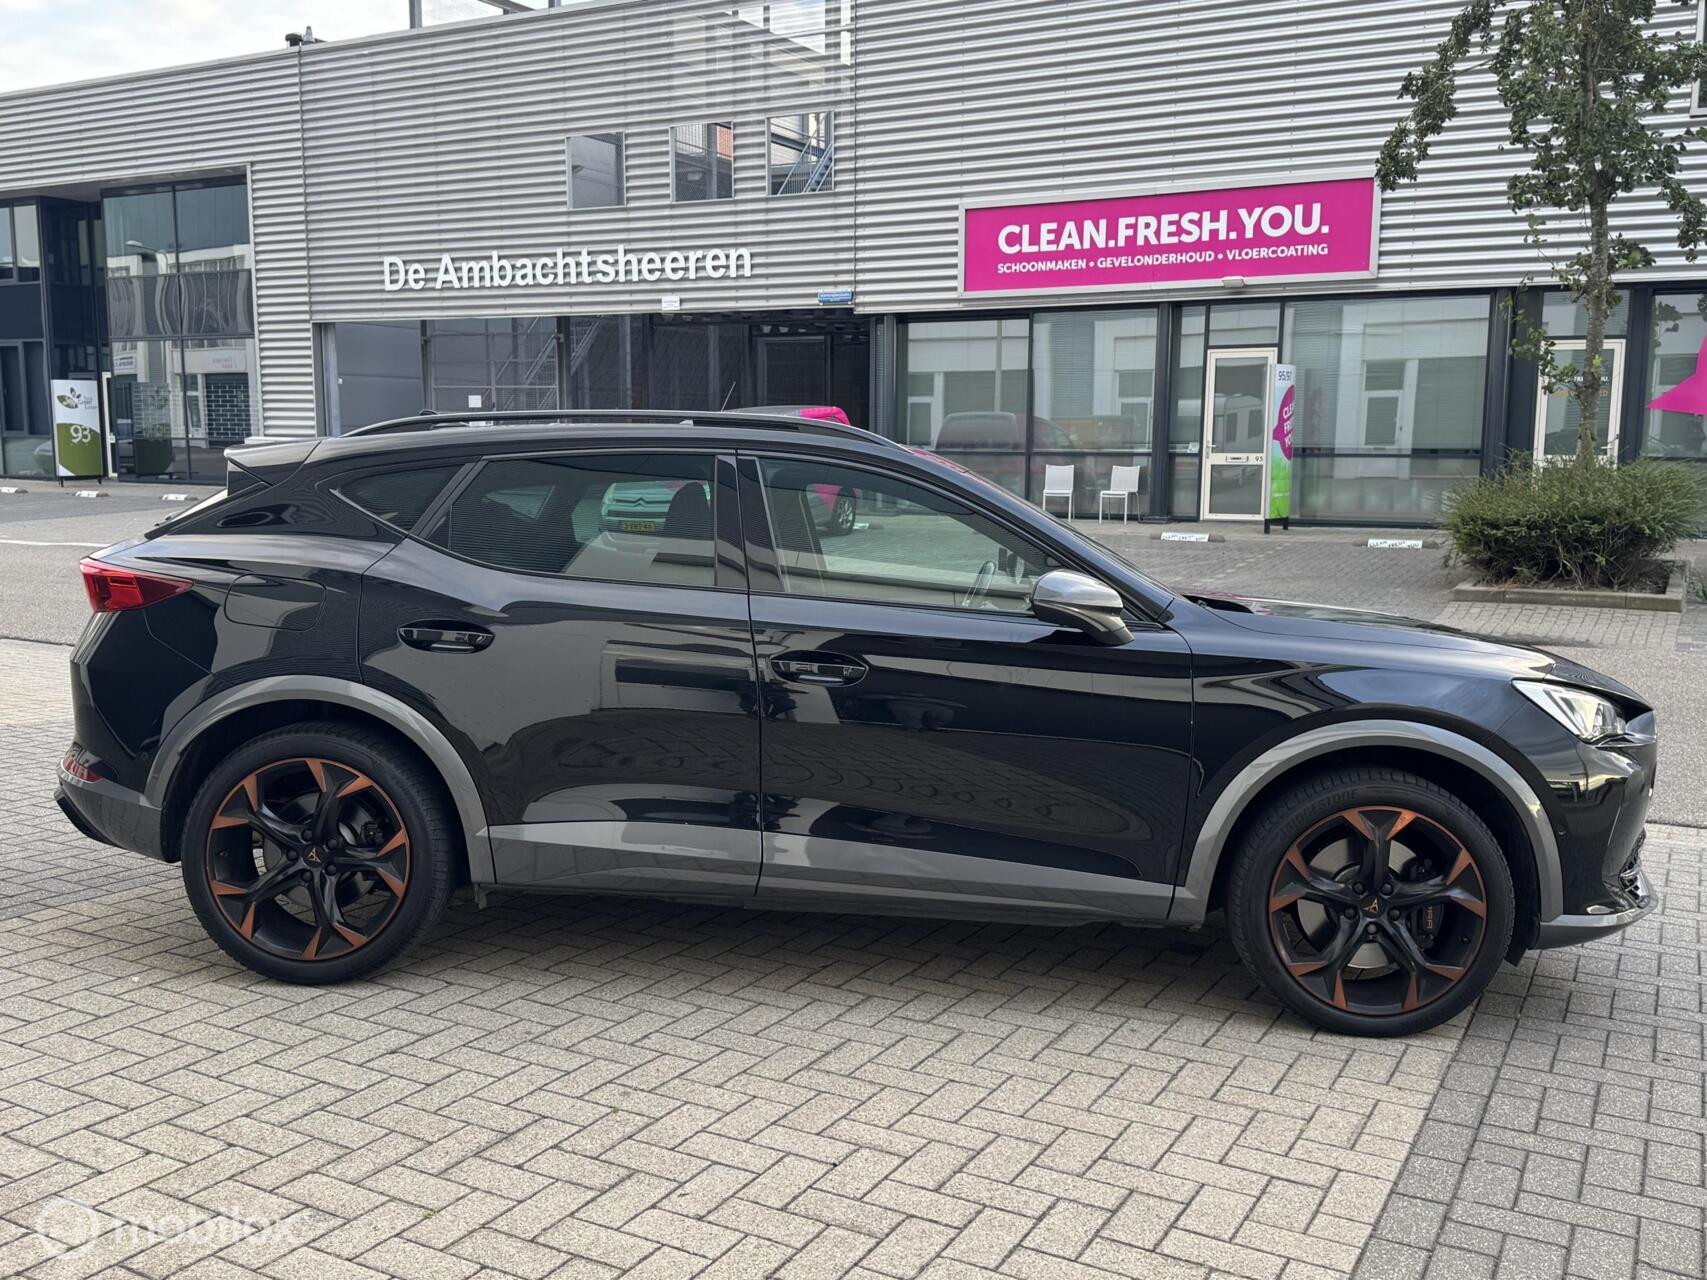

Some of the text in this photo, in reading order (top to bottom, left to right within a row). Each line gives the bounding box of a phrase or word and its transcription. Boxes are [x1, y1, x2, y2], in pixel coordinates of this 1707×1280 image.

[998, 202, 1330, 254] CLEAN.FRESH.YOU.
[383, 245, 752, 291] De Ambachtsheeren
[998, 243, 1328, 273] SCHOONMAKEN GEVELONDERHOUD VLOERCOATING
[70, 424, 91, 444] 93
